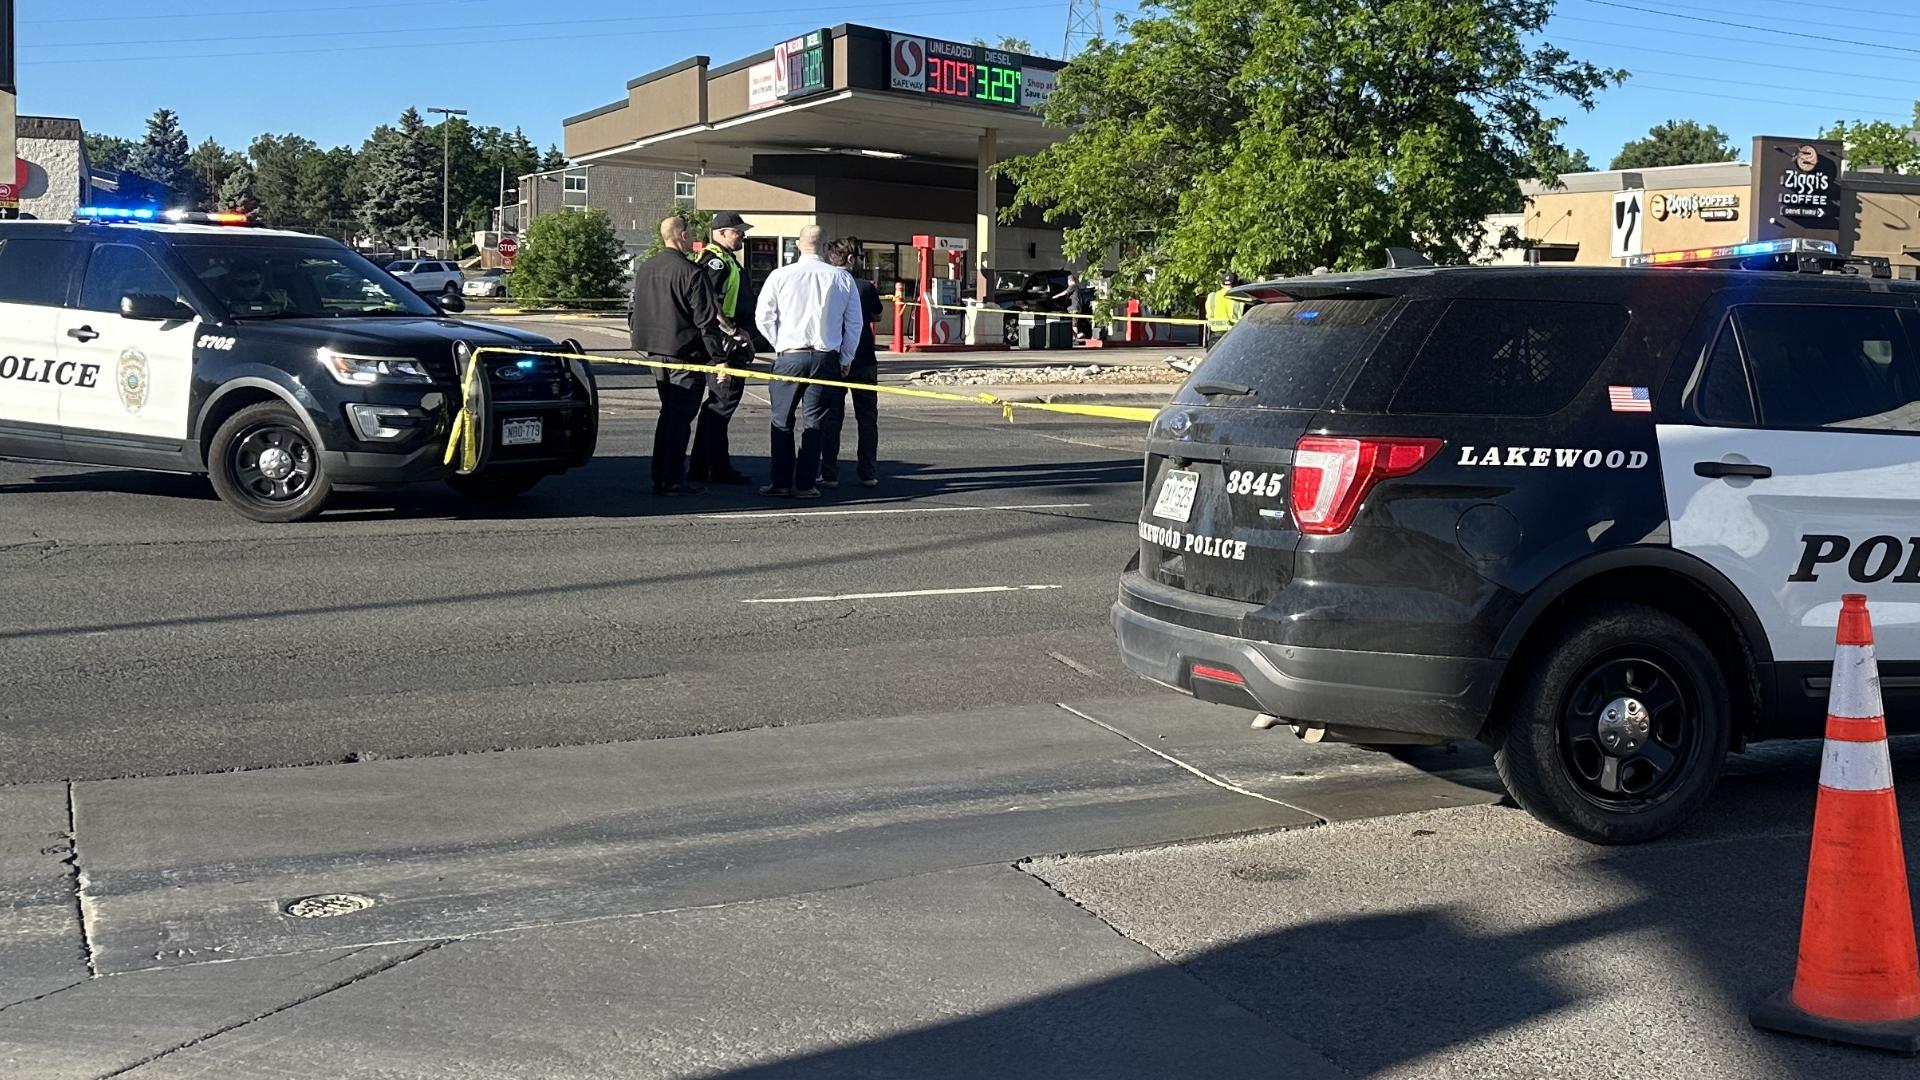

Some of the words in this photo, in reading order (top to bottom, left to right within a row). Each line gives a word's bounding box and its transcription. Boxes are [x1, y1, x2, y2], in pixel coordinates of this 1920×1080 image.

[930, 40, 972, 58] UNLEADED
[985, 51, 1011, 65] DIESEL
[893, 79, 923, 90] SAFEWAY
[1028, 79, 1045, 89] Shop
[1025, 89, 1040, 98] Save
[1785, 170, 1829, 194] Ziggi's
[1698, 195, 1737, 207] COFFEE
[1783, 194, 1828, 205] COFFEE
[500, 243, 517, 252] STOP
[1457, 446, 1648, 469] LAKEWOOD
[1226, 470, 1285, 497] 3845
[1184, 533, 1248, 561] POLICE
